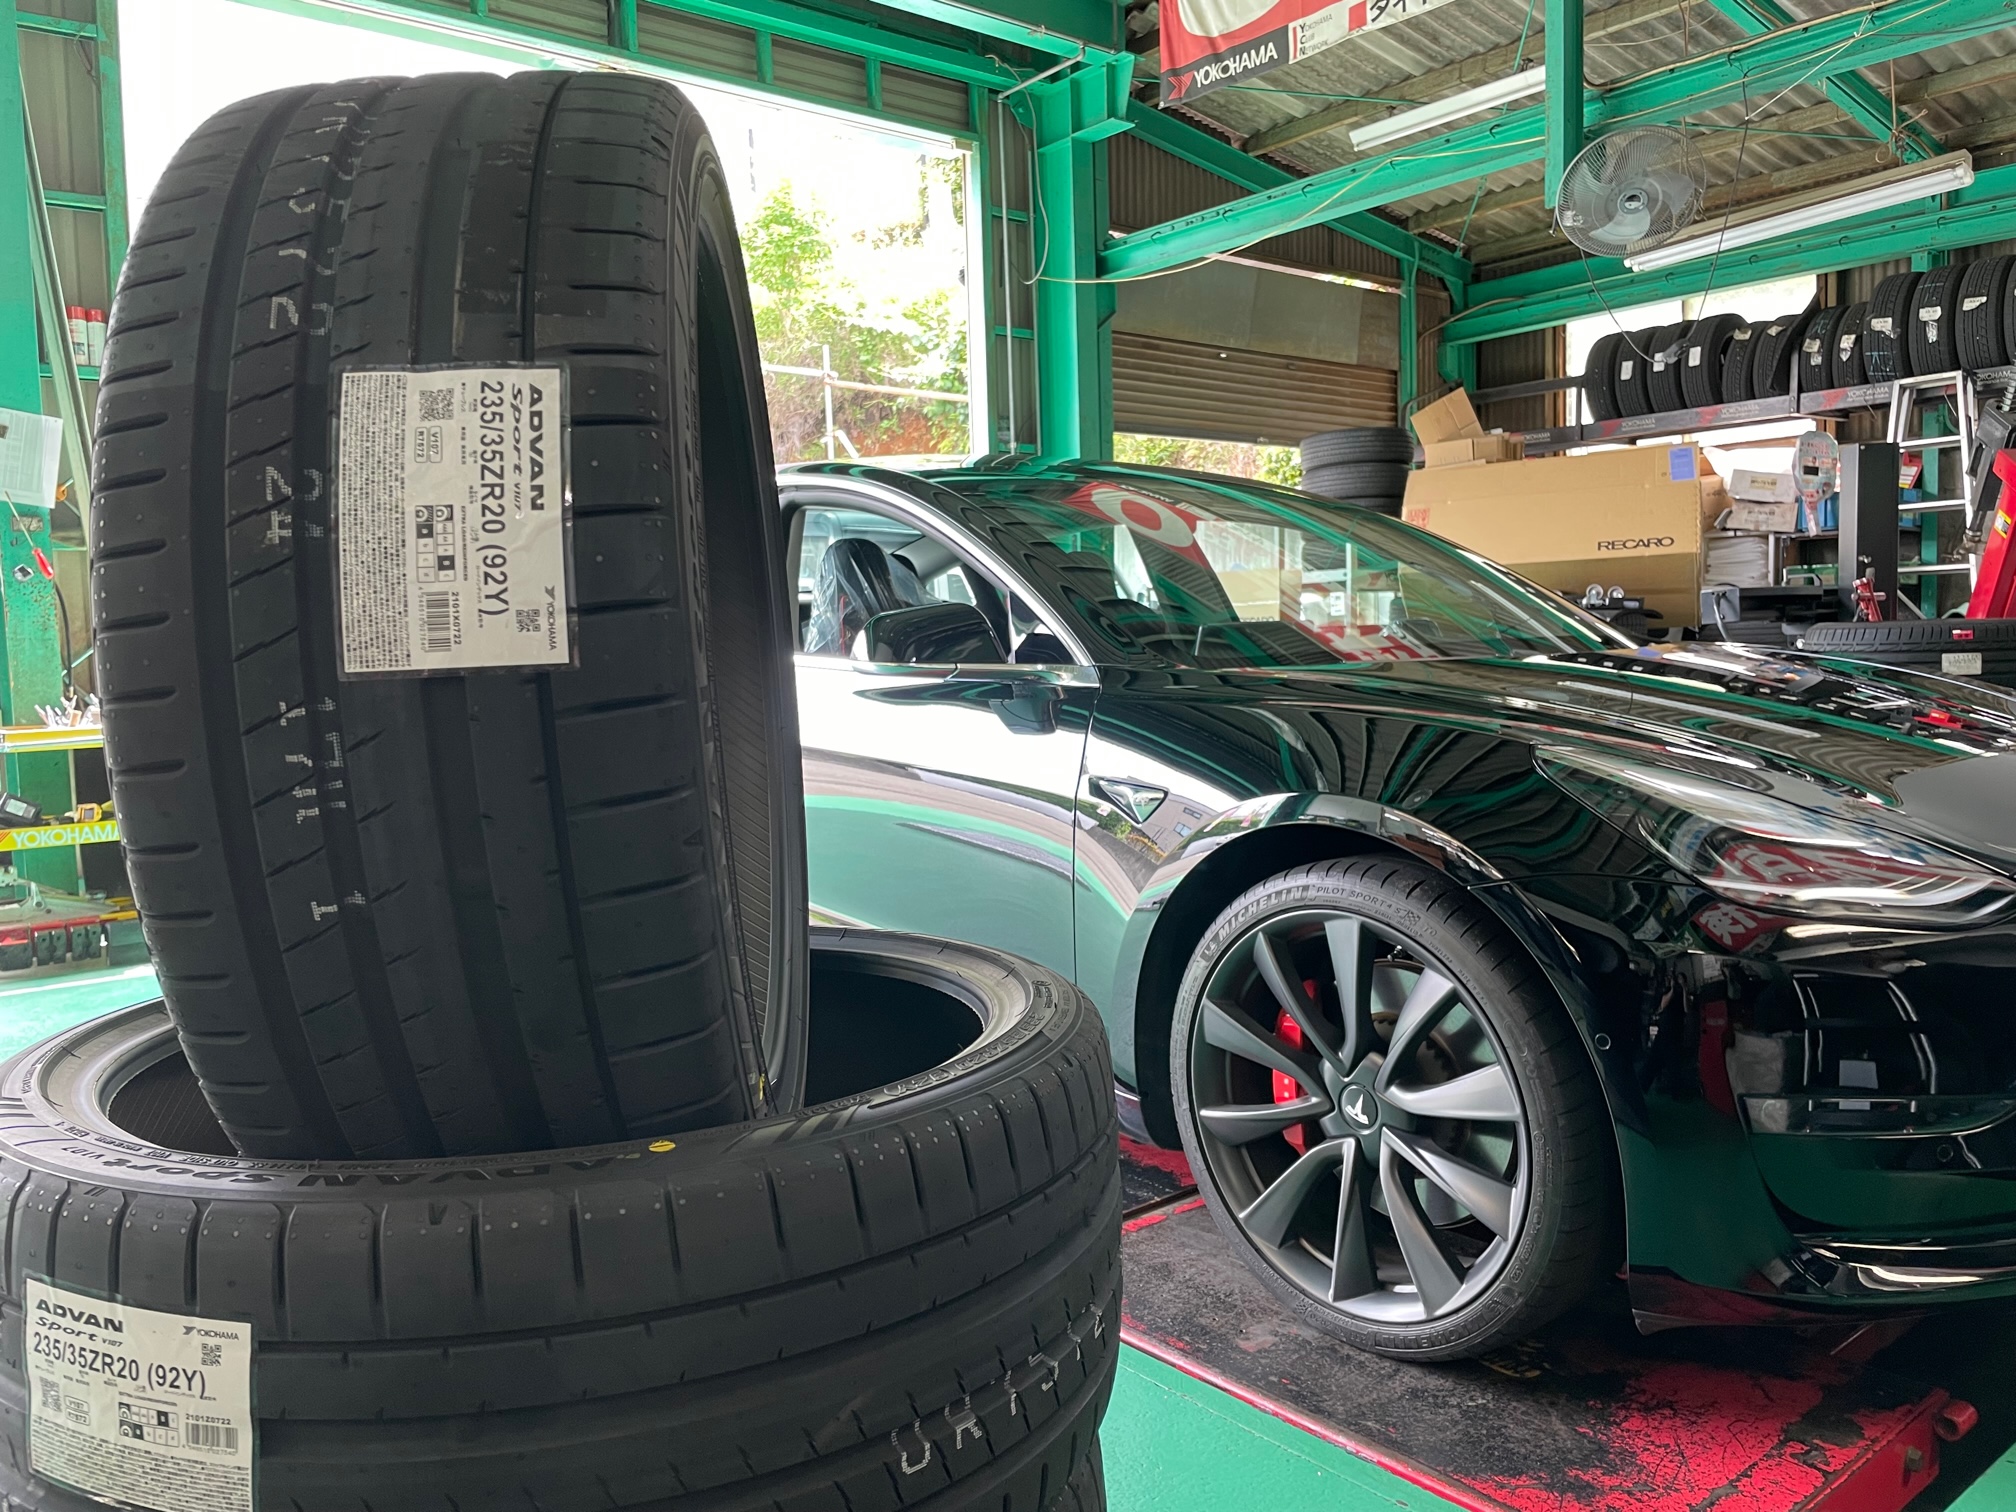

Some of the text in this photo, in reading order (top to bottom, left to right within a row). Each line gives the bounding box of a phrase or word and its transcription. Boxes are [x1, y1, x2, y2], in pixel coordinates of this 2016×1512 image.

[1193, 41, 1278, 88] YOKOHAMA
[1847, 387, 1889, 397] YOKOHAMA
[430, 431, 439, 456] V107
[511, 383, 524, 478] Sport
[529, 383, 545, 511] ADVAN
[476, 381, 510, 616] 235/35ZR20 (92Y)
[1597, 537, 1674, 551] RECARO
[452, 591, 461, 645] 2101X0722
[547, 600, 558, 651] YOKOHAMA
[1218, 887, 1303, 941] MICHELIN
[1316, 886, 1346, 896] PILOT
[1350, 890, 1387, 908] SPORT
[102, 1157, 289, 1185] Sport
[35, 1316, 124, 1347] Sport V107
[36, 1298, 124, 1333] ADVAN
[196, 1329, 239, 1341] YOKOHAMA
[33, 1331, 206, 1400] 235/35ZR20 (92Y)
